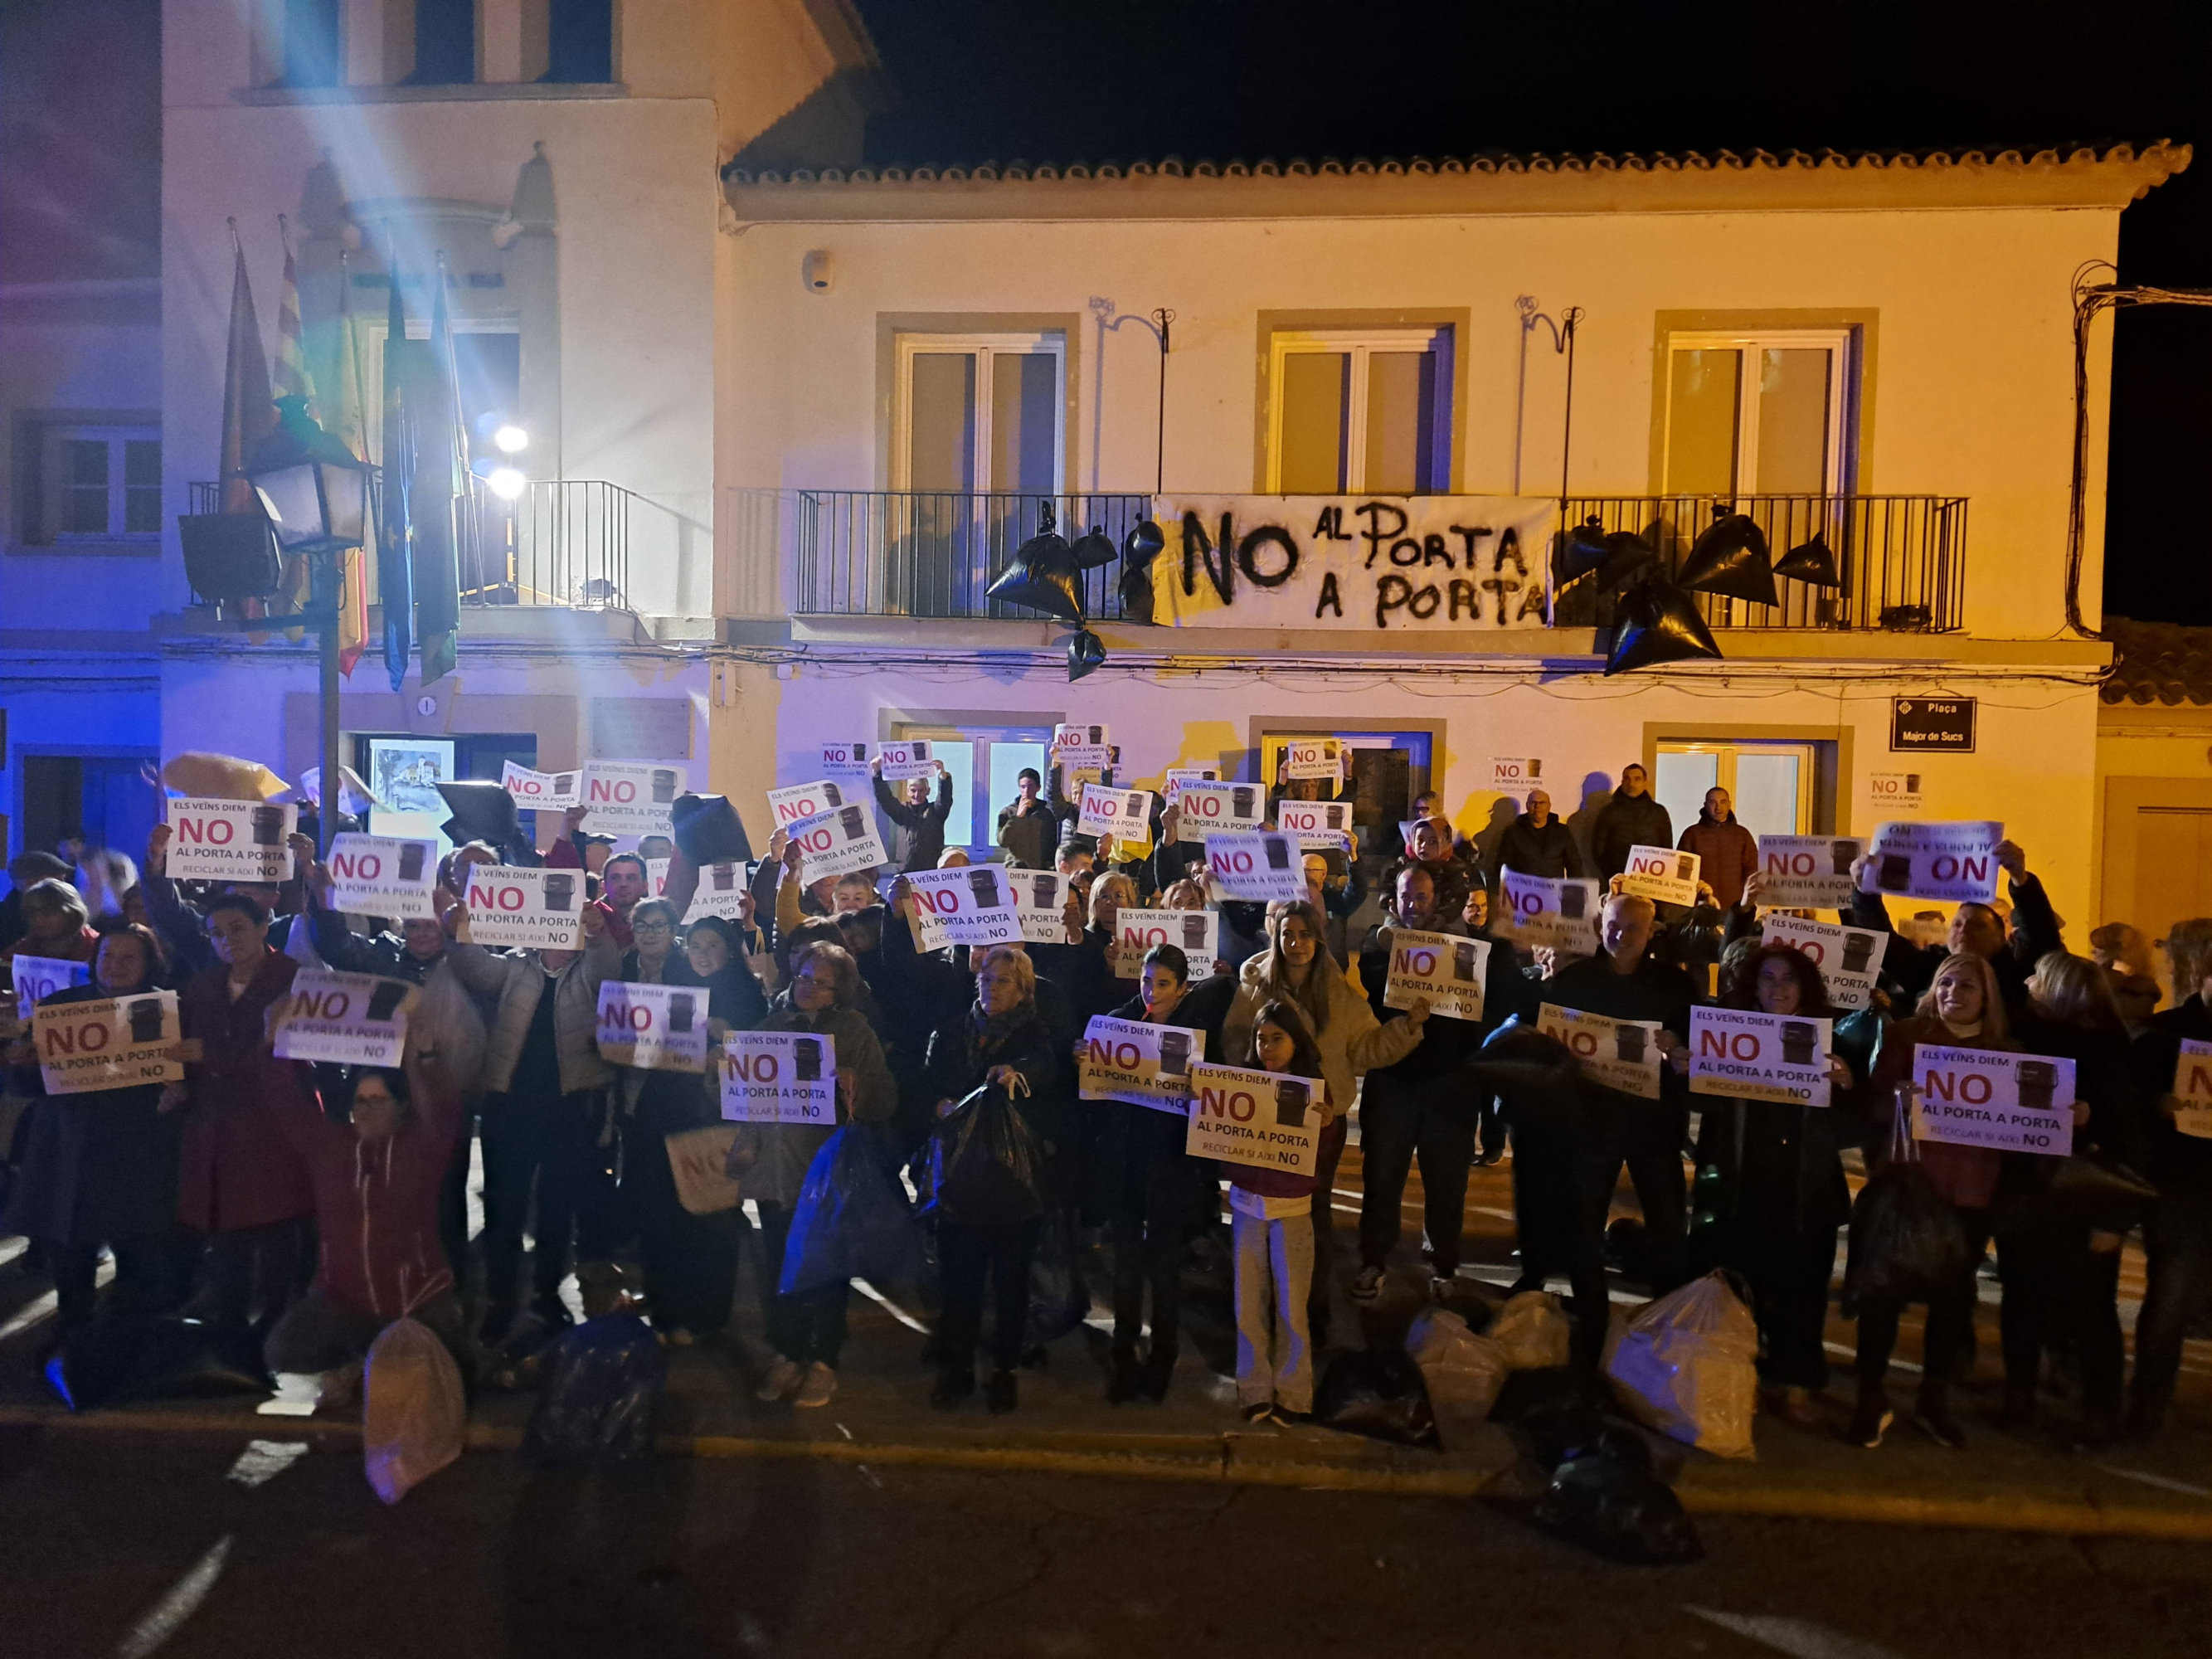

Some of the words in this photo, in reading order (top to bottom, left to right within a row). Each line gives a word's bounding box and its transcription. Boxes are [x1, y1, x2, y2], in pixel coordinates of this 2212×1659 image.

[1312, 506, 1353, 540] AL
[1355, 501, 1528, 577] PORTA
[1183, 510, 1299, 606] NO
[1315, 572, 1343, 619] A
[1928, 703, 1957, 714] Plaça
[1058, 733, 1081, 746] NO
[1903, 731, 1927, 742] Major
[1928, 732, 1939, 741] de
[1941, 732, 1963, 741] Sucs
[824, 750, 846, 761] NO
[883, 751, 906, 763] NO
[1293, 750, 1316, 763] NO
[1495, 765, 1519, 777] NO
[507, 775, 541, 794] NO
[590, 779, 635, 803] NO
[1873, 780, 1898, 793] NO
[192, 801, 220, 810] VEÏNS
[602, 807, 634, 815] PORTA
[778, 799, 815, 820] NO
[1087, 797, 1116, 816] NO
[1184, 795, 1220, 817] NO
[818, 813, 834, 823] DIEM
[1093, 817, 1115, 825] PORTA
[1285, 814, 1315, 830] NO
[179, 818, 233, 844] NO
[793, 829, 833, 856] NO
[177, 848, 190, 856] AL
[194, 849, 232, 859] PORTA
[236, 850, 244, 859] A
[249, 851, 285, 860] PORTA
[813, 852, 839, 863] PORTA
[848, 841, 875, 854] PORTA
[858, 854, 874, 864] NO
[333, 853, 381, 879] NO
[1212, 850, 1253, 873] NO
[1632, 858, 1665, 876] NO
[1767, 852, 1815, 877] NO
[1932, 855, 1988, 882] NO
[183, 865, 224, 873] RECICLAR
[257, 867, 278, 876] NO
[484, 869, 510, 878] VEÏNS
[916, 873, 939, 883] VEÏNS
[941, 872, 962, 881] DIEM
[1640, 877, 1662, 886] PORTA
[470, 885, 524, 911] NO
[711, 896, 740, 904] PORTA
[912, 889, 959, 916] NO
[1501, 885, 1543, 915] NO
[719, 907, 735, 916] NO
[935, 917, 965, 926] PORTA
[968, 917, 975, 925] A
[977, 913, 1010, 924] PORTA
[1030, 914, 1059, 923] PORTA
[486, 914, 524, 925] PORTA
[528, 917, 536, 925] A
[540, 917, 577, 927] PORTA
[1772, 919, 1786, 927] ELS
[1788, 921, 1815, 932] VEÏNS
[1817, 927, 1841, 937] DIEM
[474, 931, 515, 940] RECICLAR
[548, 932, 568, 943] NO
[929, 932, 964, 944] RECICLAR
[989, 928, 1007, 938] NO
[1037, 928, 1053, 937] NO
[1124, 927, 1168, 949] NO
[1428, 937, 1450, 946] DIEM
[1394, 948, 1436, 977] NO
[1402, 980, 1433, 992] PORTA
[1437, 985, 1444, 994] A
[1447, 987, 1479, 999] PORTA
[1834, 976, 1869, 990] PORTA
[292, 990, 349, 1019] NO
[1839, 993, 1858, 1004] NO
[1455, 1002, 1472, 1013] NO
[605, 1002, 652, 1031] NO
[1697, 1011, 1713, 1020] ELS
[1716, 1013, 1744, 1024] VEÏNS
[1748, 1017, 1774, 1026] DIEM
[1091, 1020, 1102, 1029] ELS
[1104, 1022, 1128, 1033] VEÏNS
[1130, 1027, 1155, 1036] DIEM
[46, 1022, 109, 1055] NO
[1546, 1025, 1597, 1057] NO
[1701, 1029, 1760, 1062] NO
[364, 1045, 385, 1058] NO
[1090, 1038, 1140, 1070] NO
[1922, 1051, 1939, 1060] ELS
[1942, 1051, 1975, 1063] VEÏNS
[1979, 1056, 2009, 1066] DIEM
[68, 1055, 110, 1068] PORTA
[728, 1054, 778, 1082] NO
[140, 1065, 163, 1077] NO
[1087, 1068, 1101, 1078] AL
[1105, 1069, 1140, 1085] PORTA
[1144, 1078, 1151, 1087] A
[1198, 1068, 1213, 1077] ELS
[1216, 1070, 1243, 1081] VEÏNS
[1246, 1075, 1271, 1086] DIEM
[1699, 1062, 1713, 1072] AL
[1718, 1064, 1760, 1077] PORTA
[1764, 1070, 1773, 1078] A
[1777, 1070, 1821, 1083] PORTA
[728, 1086, 740, 1096] AL
[743, 1087, 779, 1097] PORTA
[782, 1089, 790, 1097] A
[792, 1089, 826, 1099] PORTA
[1787, 1087, 1811, 1099] NO
[1926, 1069, 1992, 1105] NO
[1165, 1097, 1185, 1108] NO
[1200, 1087, 1256, 1121] NO
[802, 1106, 820, 1117] NO
[1923, 1104, 1939, 1116] AL
[1944, 1107, 1991, 1121] PORTA
[1996, 1113, 2006, 1124] A
[2011, 1115, 2060, 1131] PORTA
[1197, 1121, 1211, 1132] AL
[1215, 1123, 1253, 1139] PORTA
[1257, 1131, 1266, 1141] A
[1270, 1132, 1309, 1148] PORTA
[2024, 1133, 2049, 1147] NO
[1203, 1141, 1244, 1155] RECICLAR
[1278, 1151, 1300, 1165] NO
